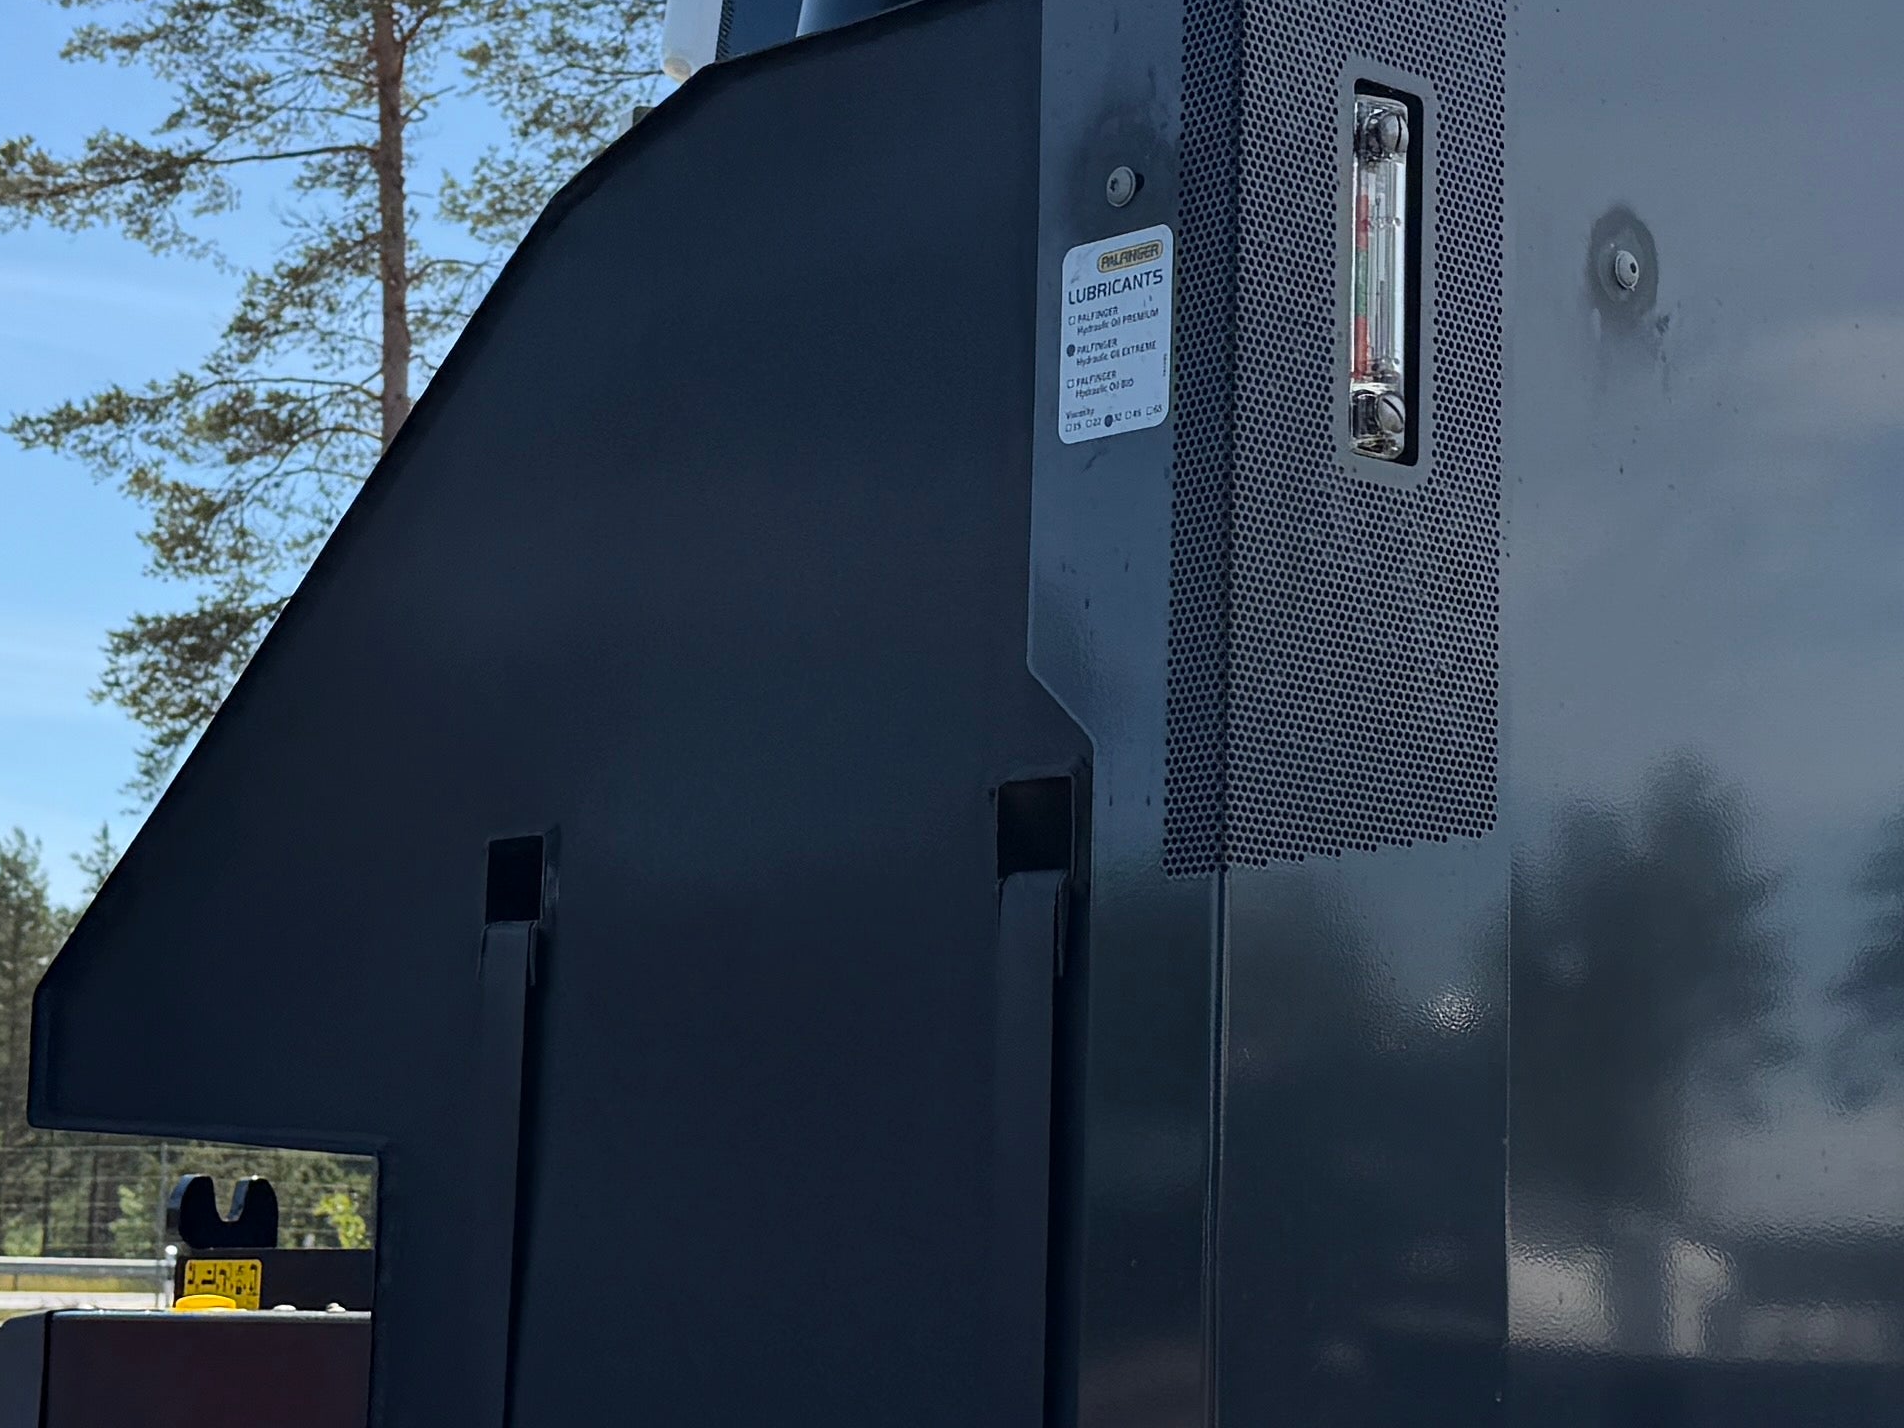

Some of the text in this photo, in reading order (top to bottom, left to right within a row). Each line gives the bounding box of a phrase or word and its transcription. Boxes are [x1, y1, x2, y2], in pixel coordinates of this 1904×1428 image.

[1100, 243, 1160, 270] PALFINGER
[1068, 269, 1164, 306] LUBRICANTS
[1077, 306, 1118, 323] PALFINGER
[1076, 338, 1118, 354] PALFINGER
[1122, 340, 1157, 356] EXTREME
[1076, 370, 1117, 387] PALFINGER
